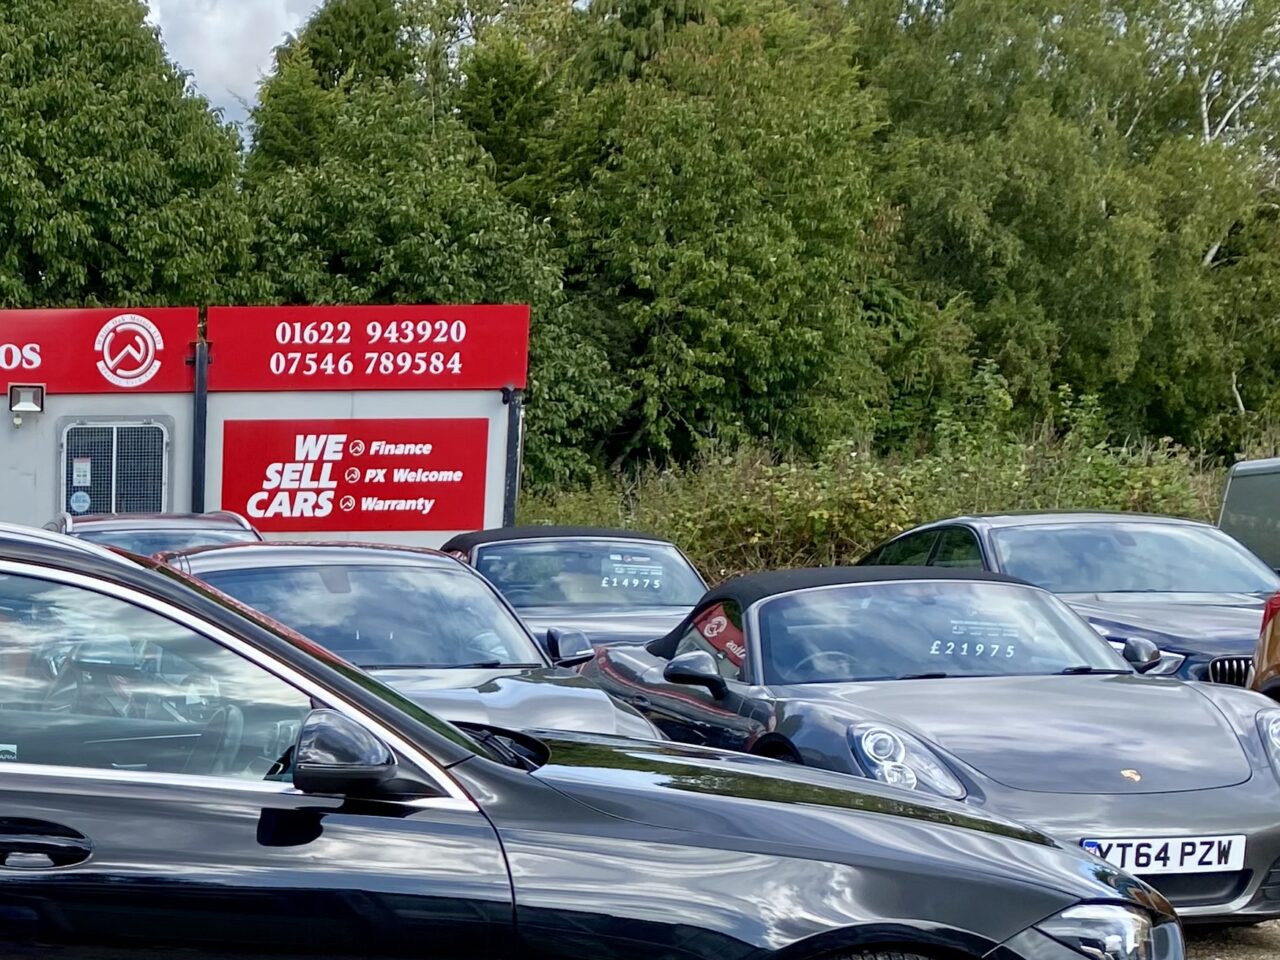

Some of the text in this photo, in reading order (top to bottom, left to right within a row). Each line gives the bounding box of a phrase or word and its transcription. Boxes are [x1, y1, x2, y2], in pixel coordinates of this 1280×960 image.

[275, 320, 466, 345] 01622 943920
[270, 351, 462, 375] 07546 789584
[295, 435, 347, 461] WE
[369, 441, 432, 455] Finance
[262, 463, 337, 490] SELL
[364, 469, 463, 483] PX Welcome
[246, 491, 334, 518] CARS
[361, 497, 435, 514] Warranty
[601, 576, 661, 589] £14975
[929, 640, 1015, 658] £21975
[1097, 840, 1232, 869] YT64 PZW
